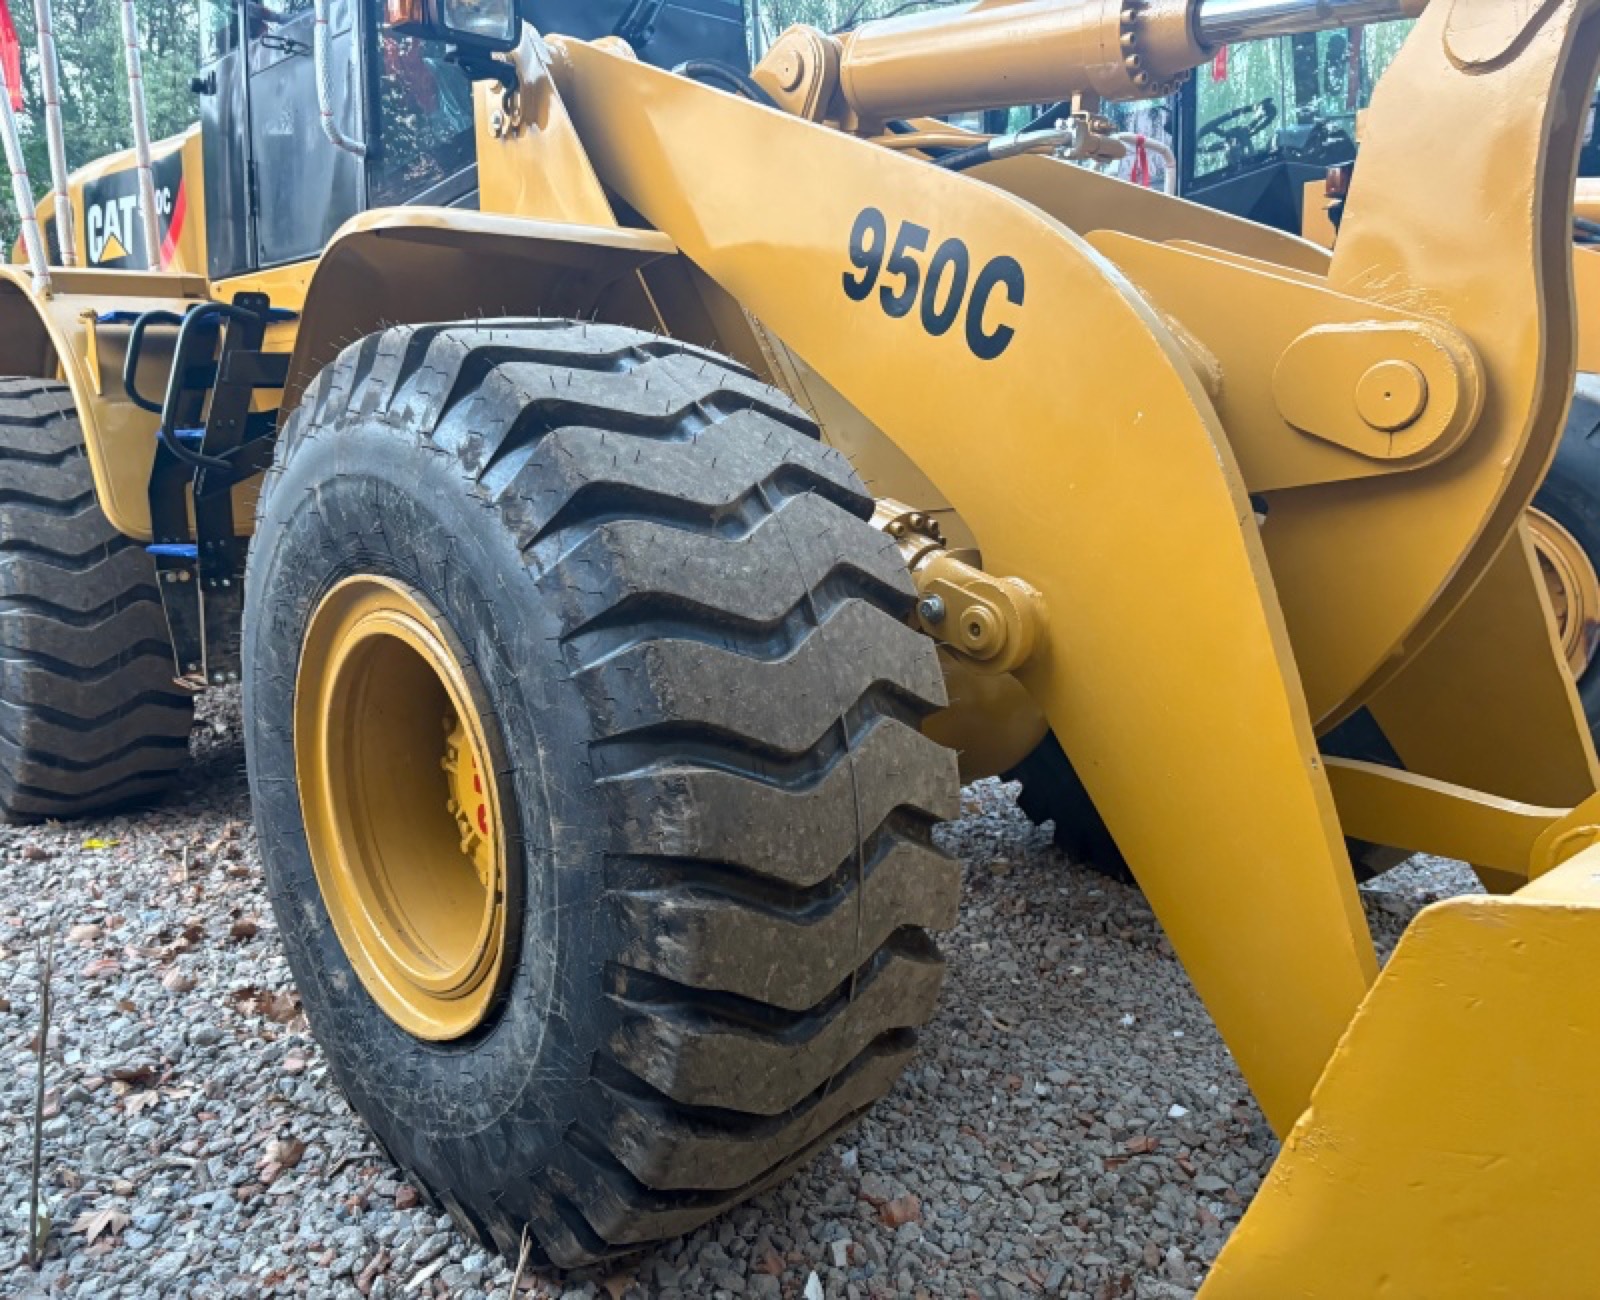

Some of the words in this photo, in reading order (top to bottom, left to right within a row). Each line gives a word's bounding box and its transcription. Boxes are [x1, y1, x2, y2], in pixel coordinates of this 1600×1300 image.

[88, 194, 136, 264] CAT
[138, 186, 171, 216] 0C
[842, 206, 1025, 361] 950C
